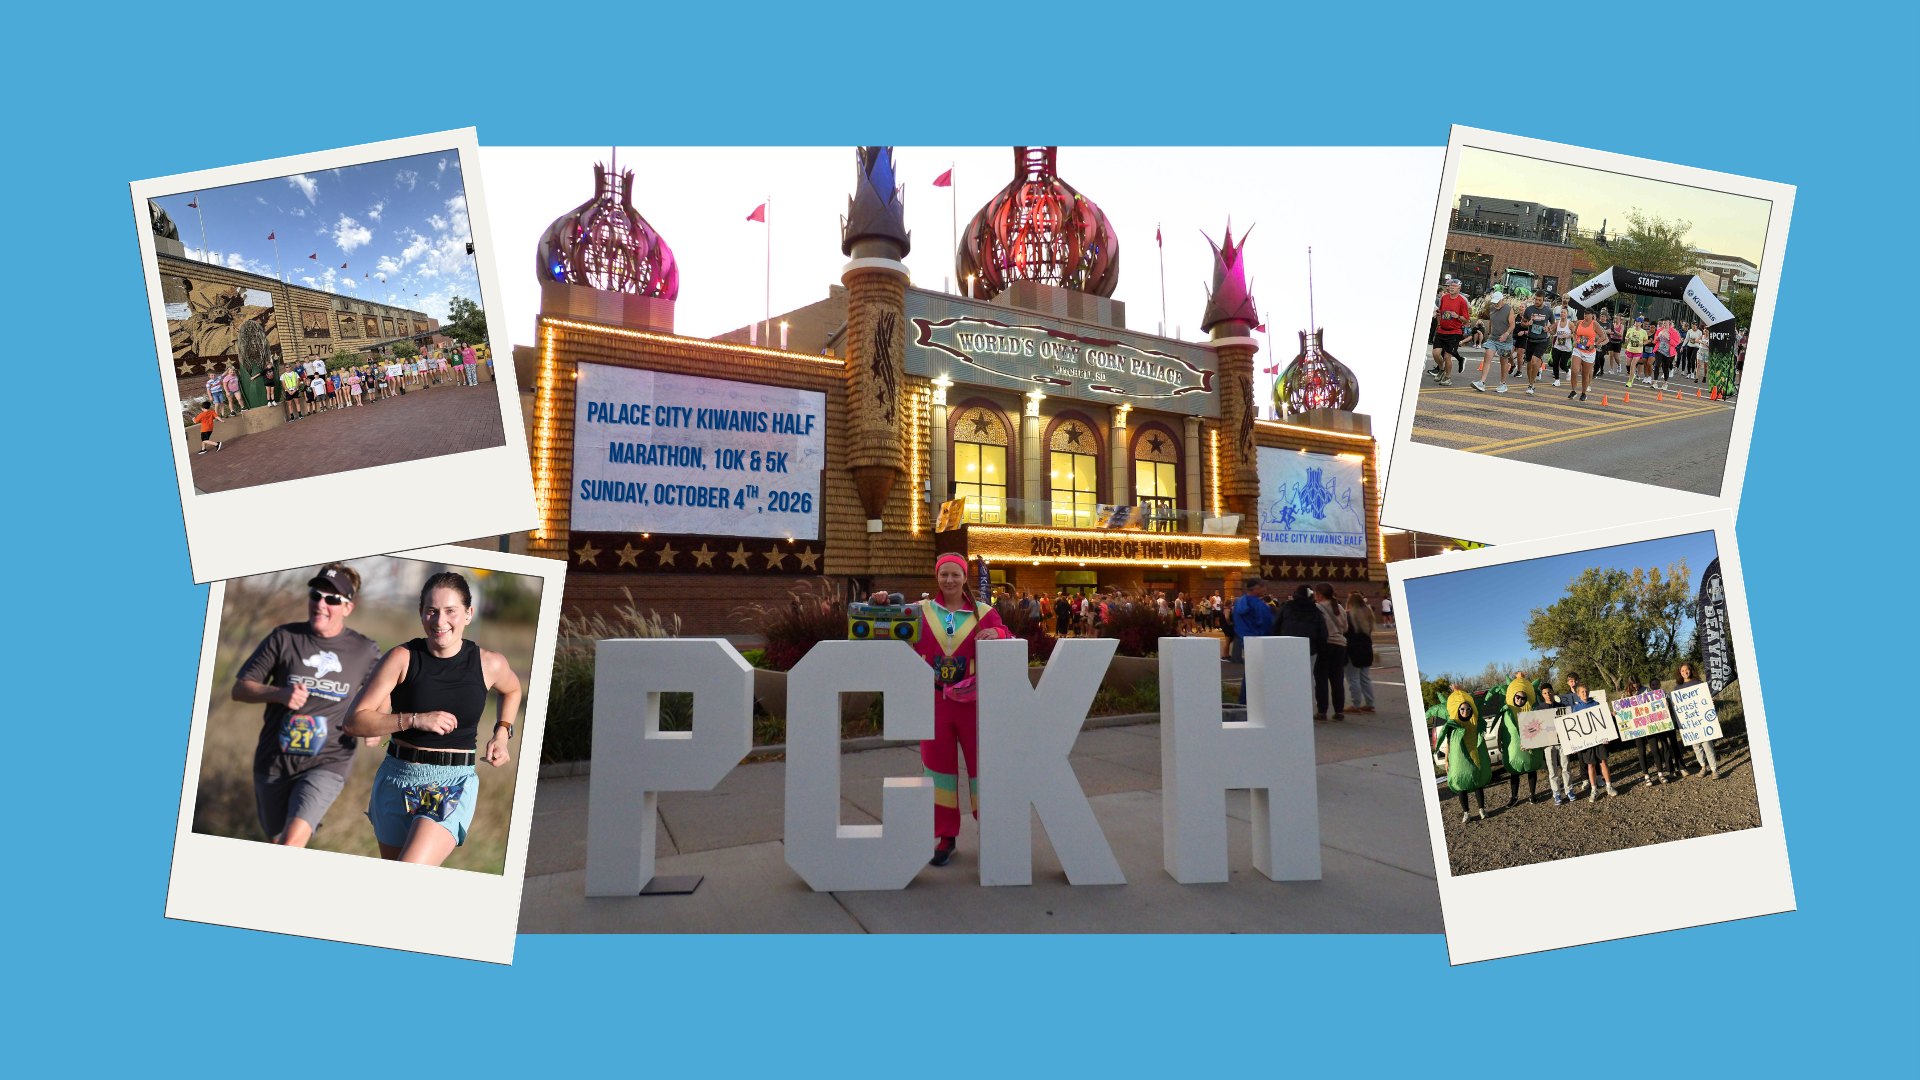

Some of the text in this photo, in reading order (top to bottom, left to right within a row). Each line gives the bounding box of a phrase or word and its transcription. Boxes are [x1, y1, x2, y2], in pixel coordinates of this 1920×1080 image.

[1638, 276, 1660, 288] START
[1692, 295, 1716, 322] Kiwanis
[307, 344, 334, 356] 1776
[957, 332, 1182, 387] WORLD'S ONLY CORN PALACE
[587, 402, 815, 436] PALACE CITY KIWANIS HALF
[609, 442, 788, 473] MARATHON, 10K & 5K
[581, 480, 812, 513] SUNDAY, OCTOBER 4TH, 2026
[1030, 536, 1202, 559] 2025 WONDERS OF THE WORLD
[1261, 532, 1363, 546] PALACE CITY KIWANIS HALF
[1704, 606, 1722, 691] BEAVERS
[941, 666, 956, 678] 87
[287, 674, 350, 694] SDSU
[1674, 688, 1699, 703] Never
[1676, 700, 1698, 713] trust
[1562, 708, 1606, 741] RUN
[1681, 719, 1703, 730] after
[1682, 726, 1714, 742] Mile 10
[290, 730, 310, 748] 21
[585, 636, 1322, 897] PCKH
